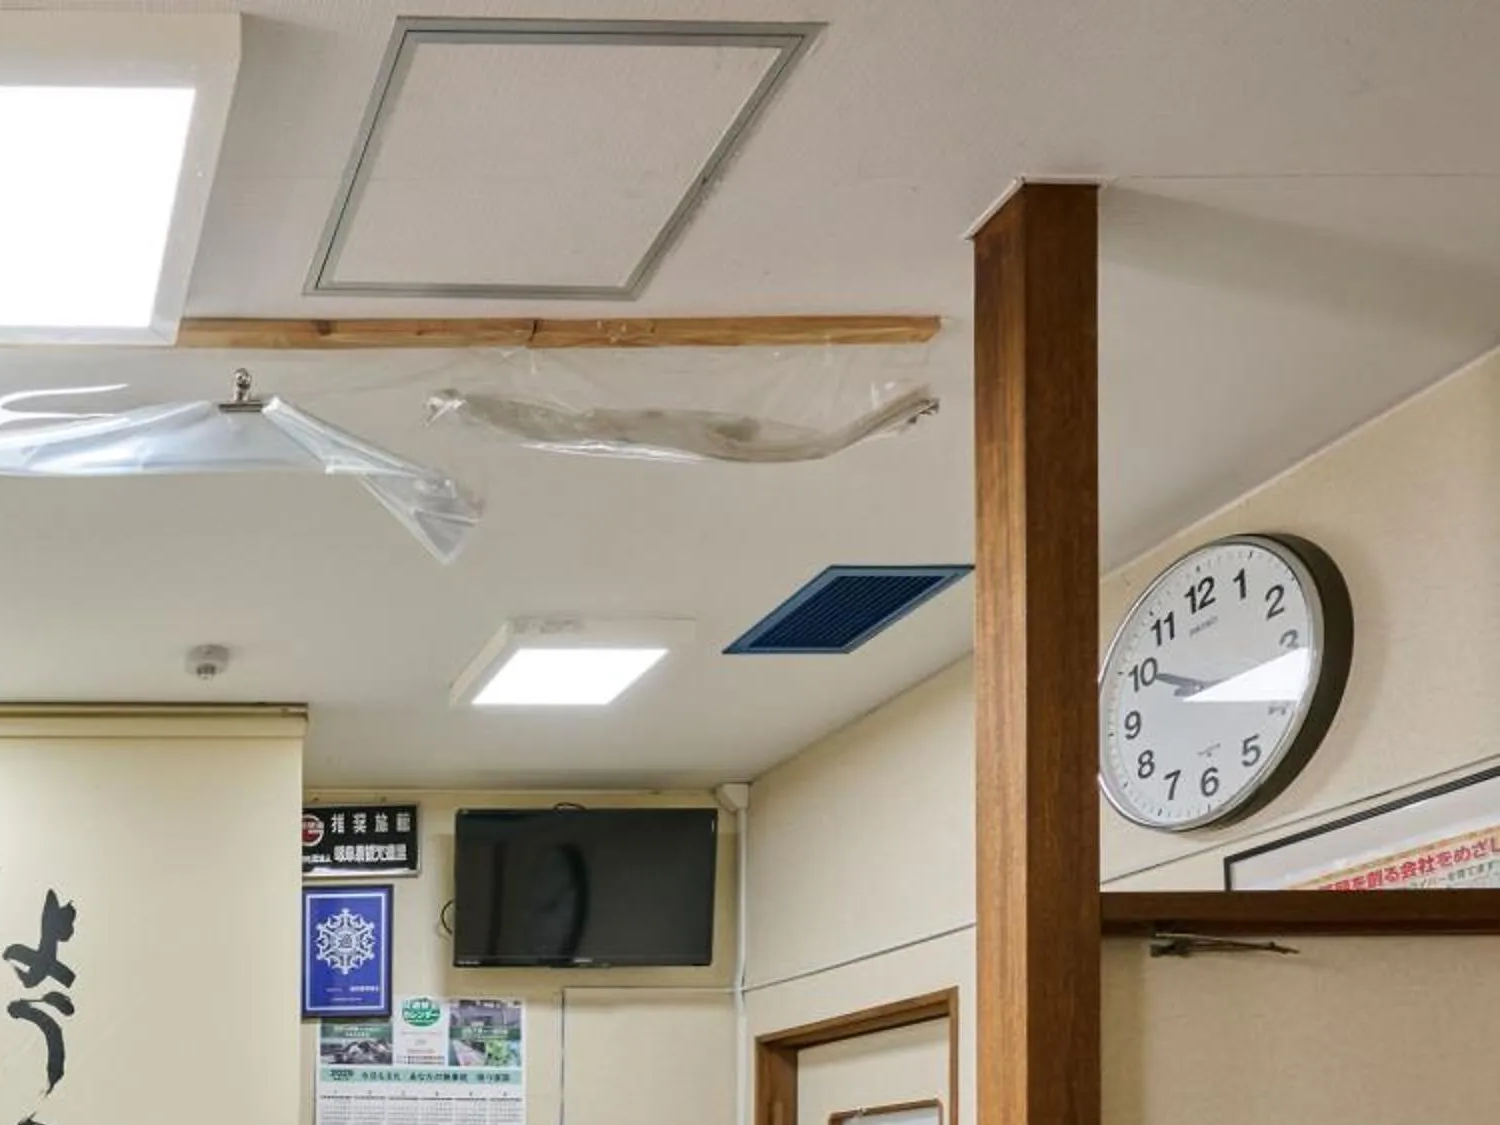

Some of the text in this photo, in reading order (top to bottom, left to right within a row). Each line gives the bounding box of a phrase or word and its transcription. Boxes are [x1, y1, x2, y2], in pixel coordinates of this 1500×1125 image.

[1184, 575, 1216, 614] 12
[1233, 569, 1249, 600] 1
[1264, 584, 1286, 621] 2
[1151, 611, 1176, 647] 11
[1128, 657, 1158, 693] 10
[1123, 710, 1142, 740] 9
[1137, 750, 1156, 779] 8
[1241, 734, 1262, 767] 5
[1163, 770, 1181, 800] 7
[1200, 767, 1220, 798] 6
